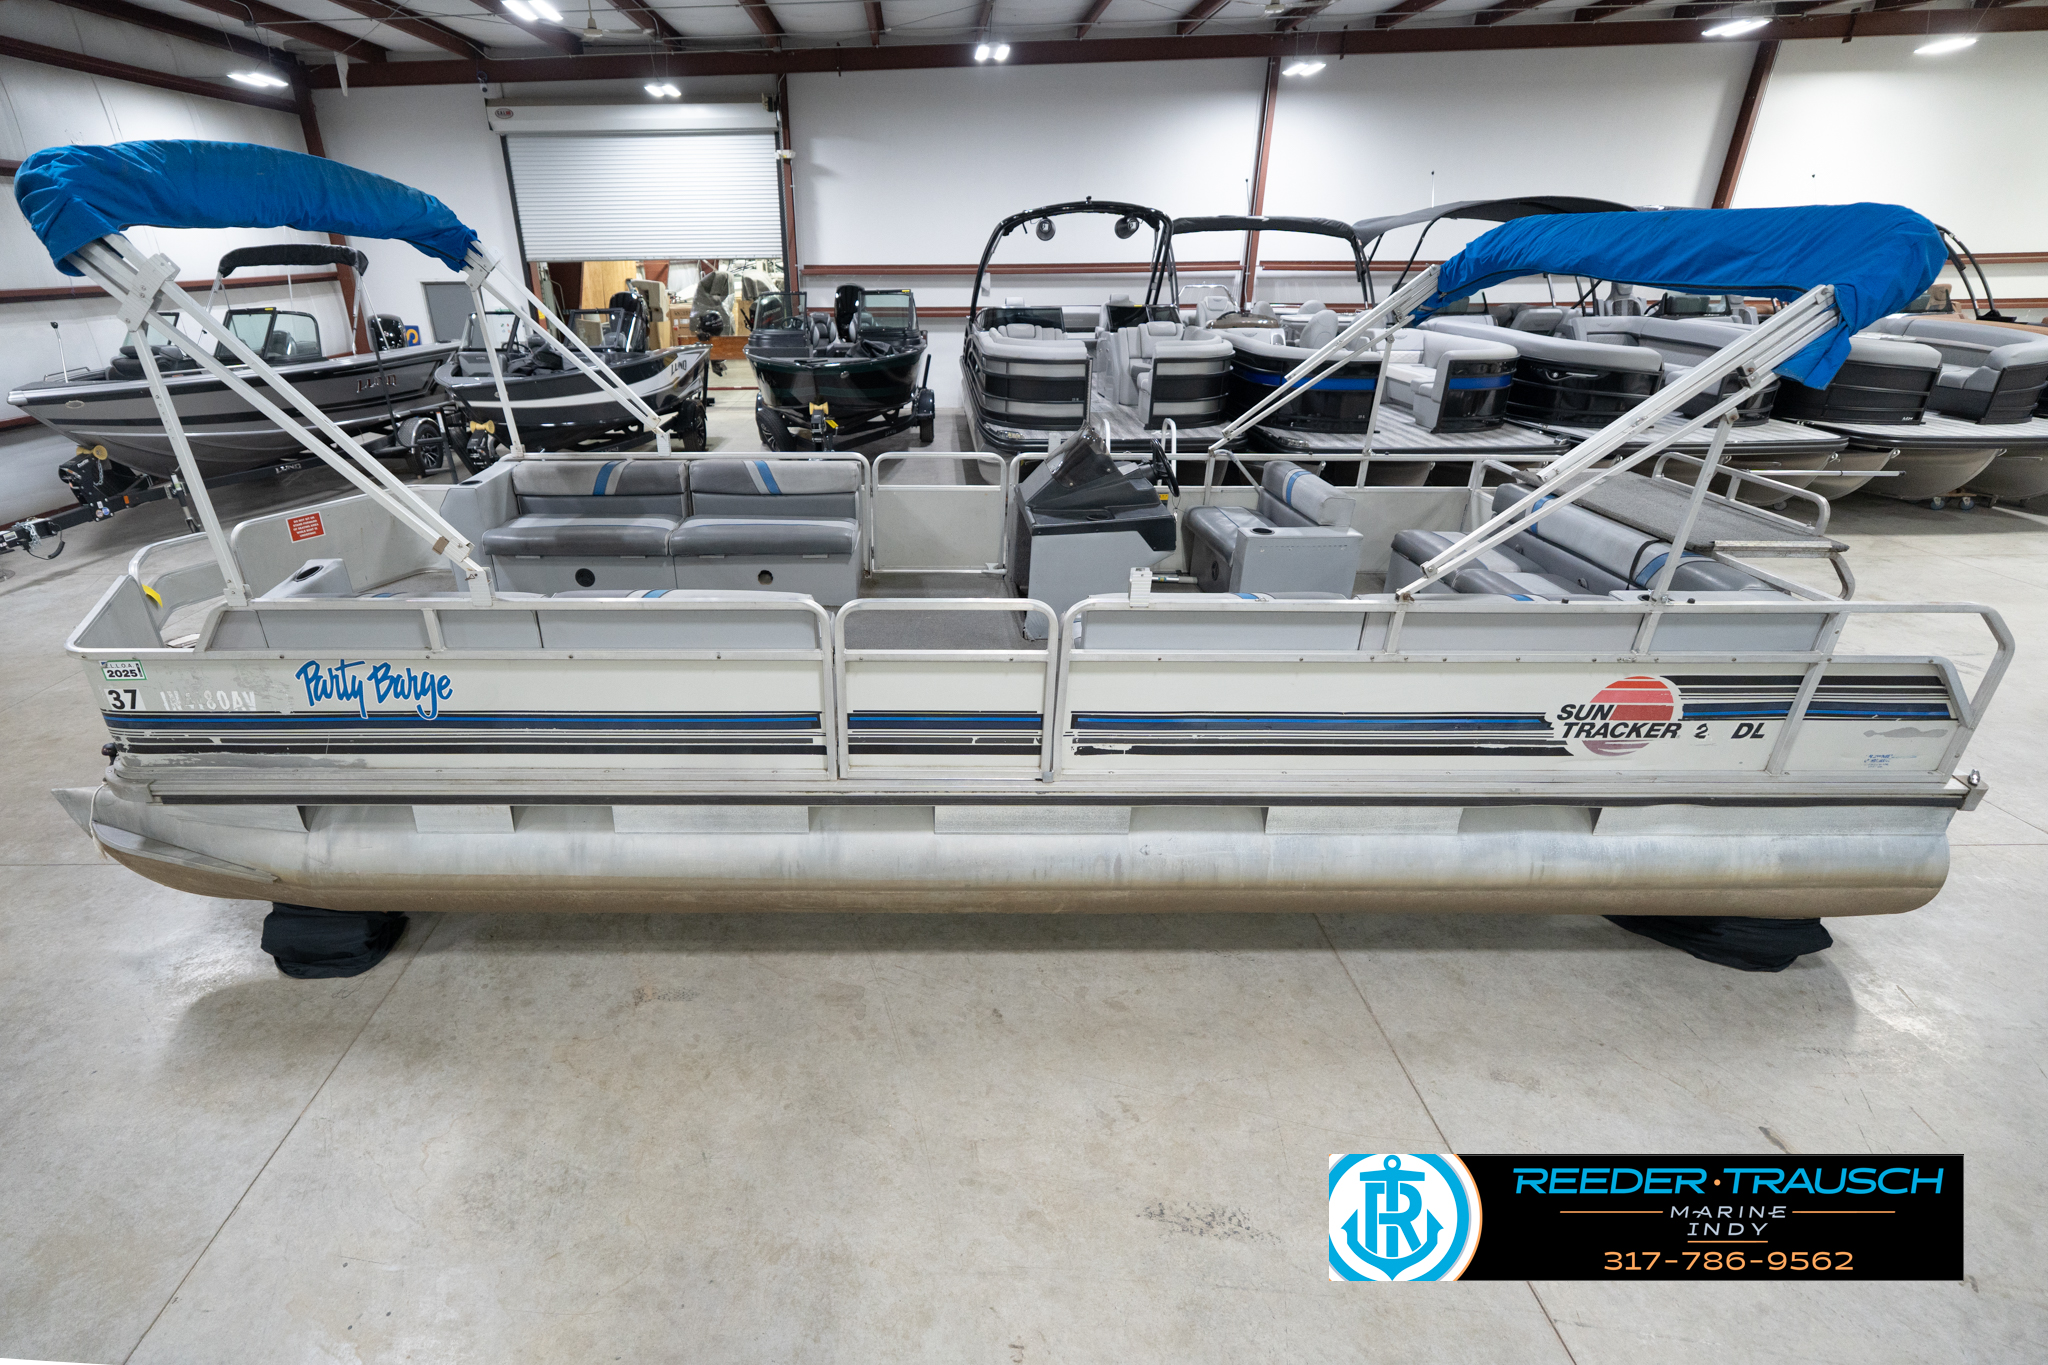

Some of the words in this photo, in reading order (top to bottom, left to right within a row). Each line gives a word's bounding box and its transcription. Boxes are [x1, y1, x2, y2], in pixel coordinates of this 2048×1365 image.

[106, 669, 138, 678] 2025
[295, 659, 368, 719] Party
[366, 661, 453, 720] Barge
[107, 689, 137, 710] 37
[1556, 704, 1615, 721] SUN
[1562, 722, 1682, 739] TRACKER
[1731, 722, 1765, 739] DL
